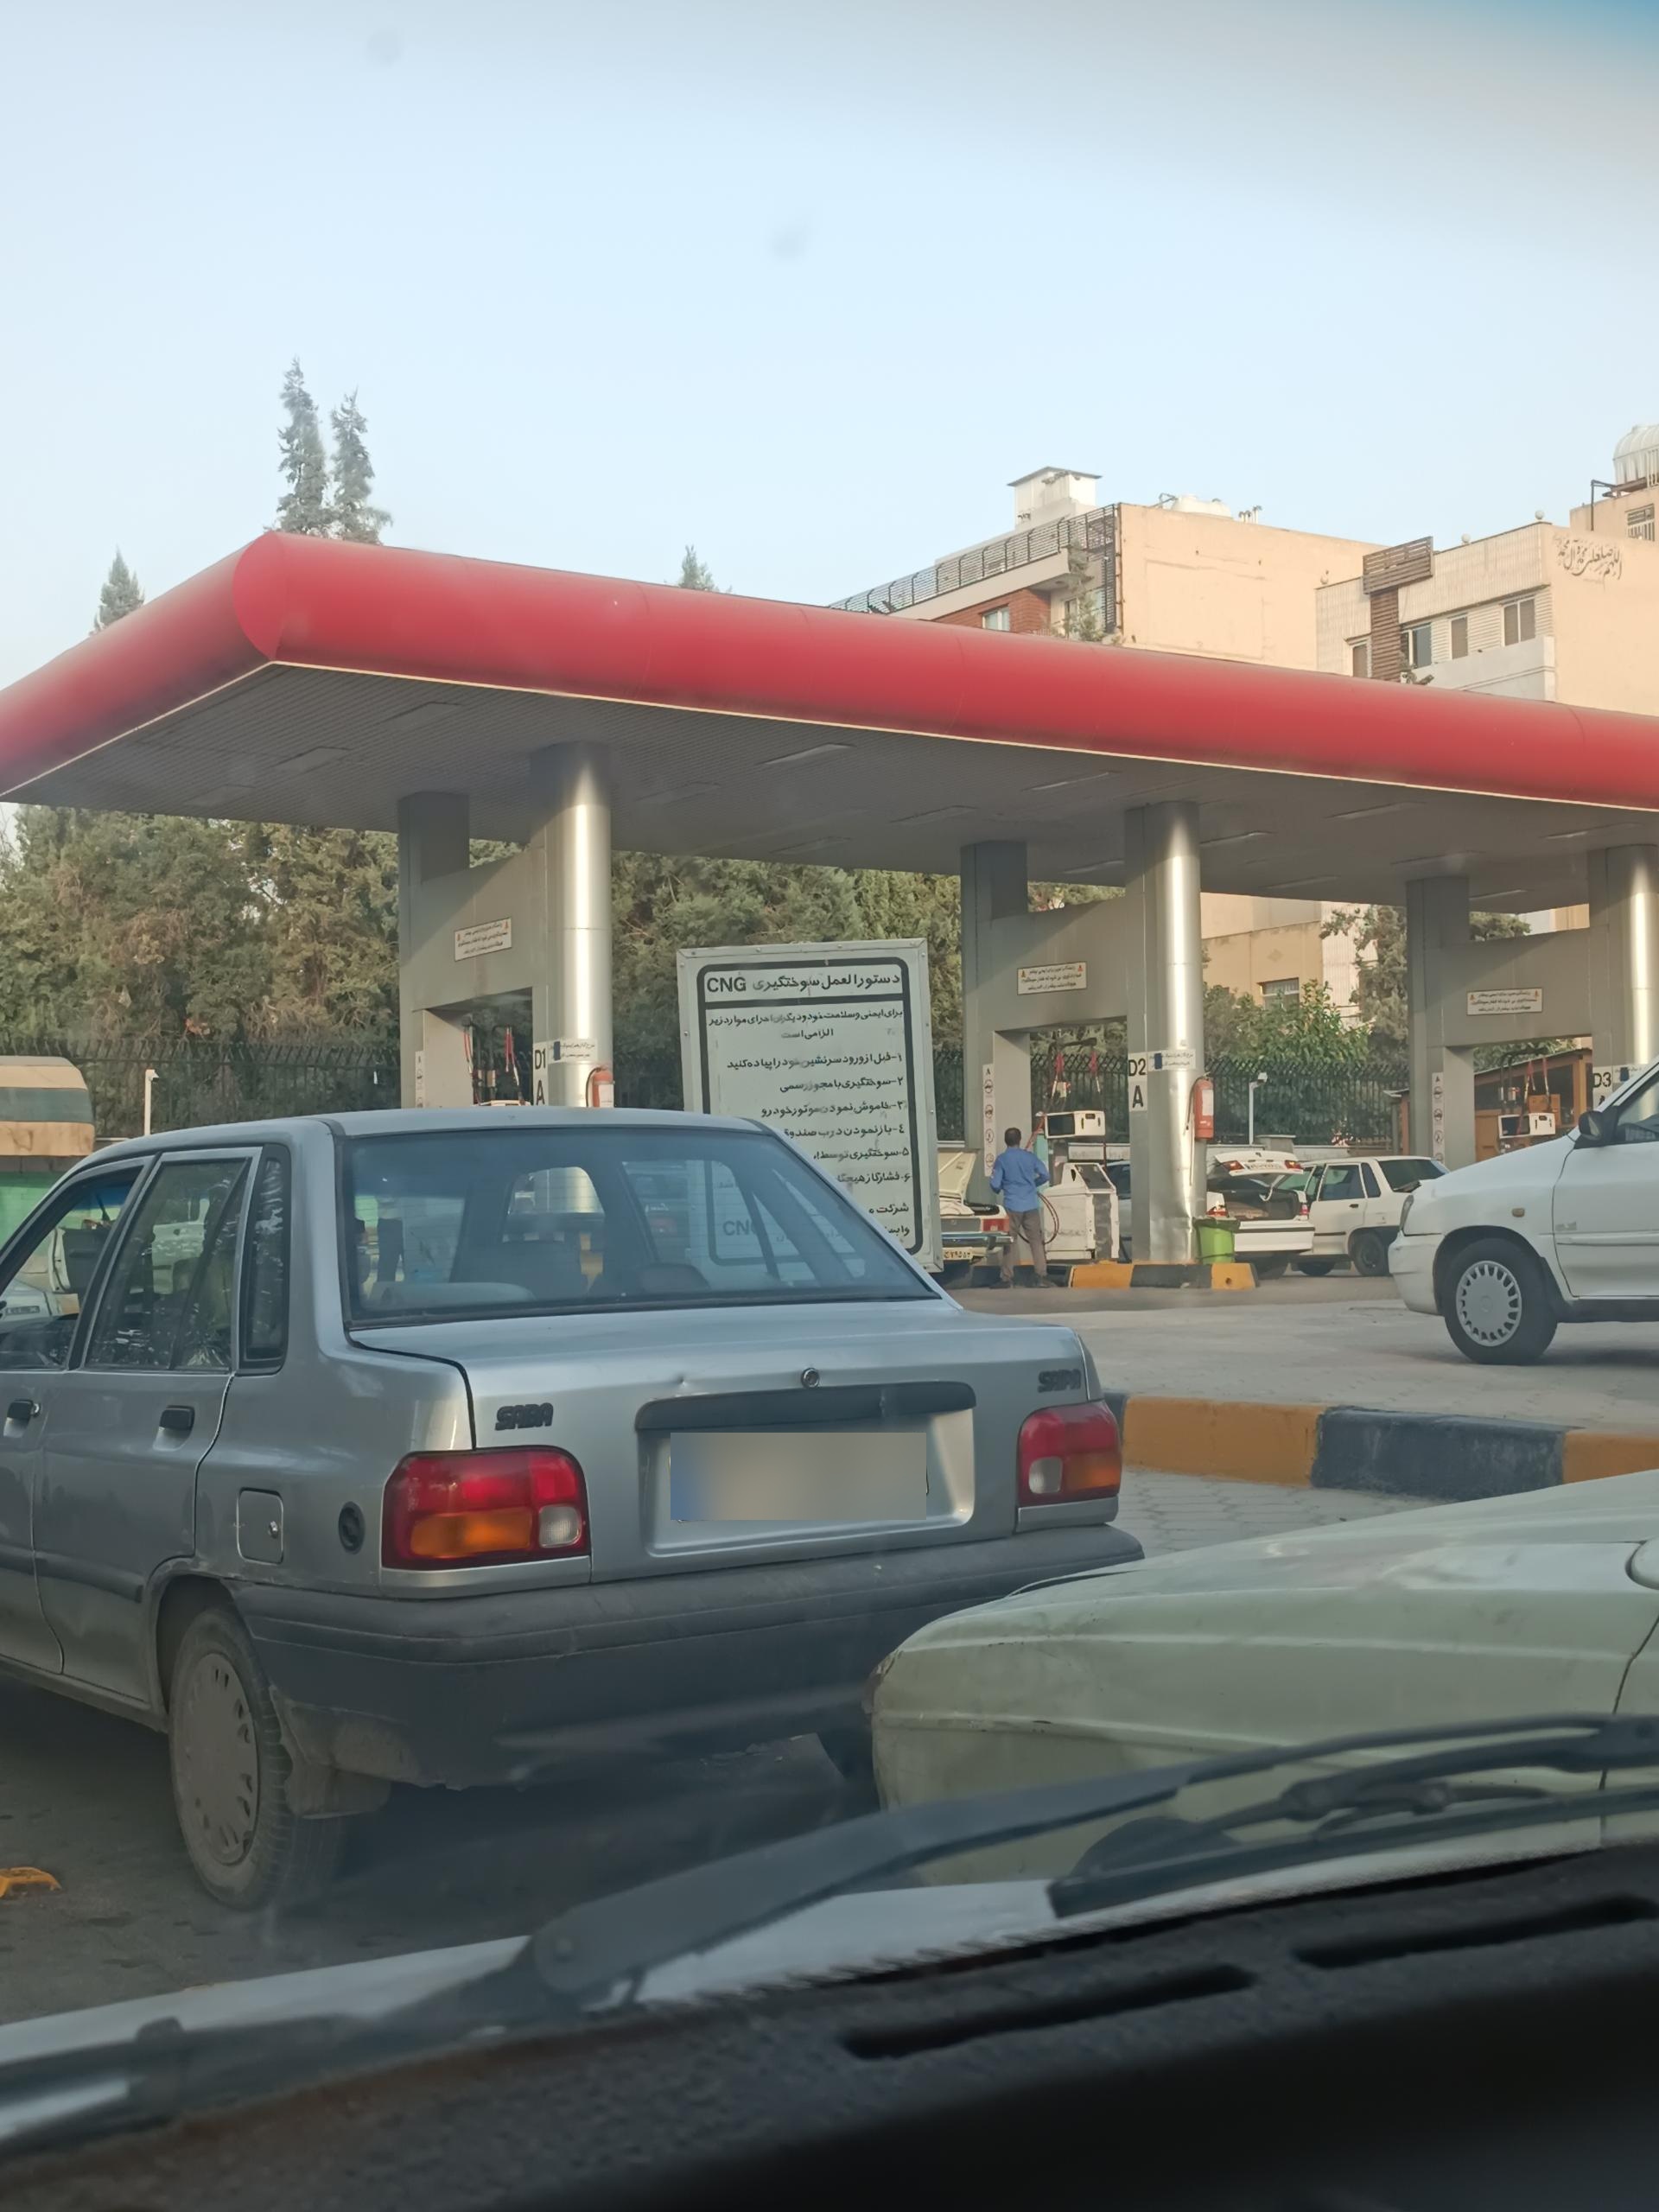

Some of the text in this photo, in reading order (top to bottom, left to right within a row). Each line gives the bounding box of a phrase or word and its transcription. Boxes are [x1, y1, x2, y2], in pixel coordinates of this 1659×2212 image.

[707, 976, 747, 993] CNG
[534, 1048, 546, 1070] D1
[1128, 1058, 1147, 1077] D2
[1592, 1071, 1612, 1088] D3
[536, 1079, 546, 1106] A
[1132, 1084, 1144, 1109] A
[721, 1202, 910, 1236] شرکت CN
